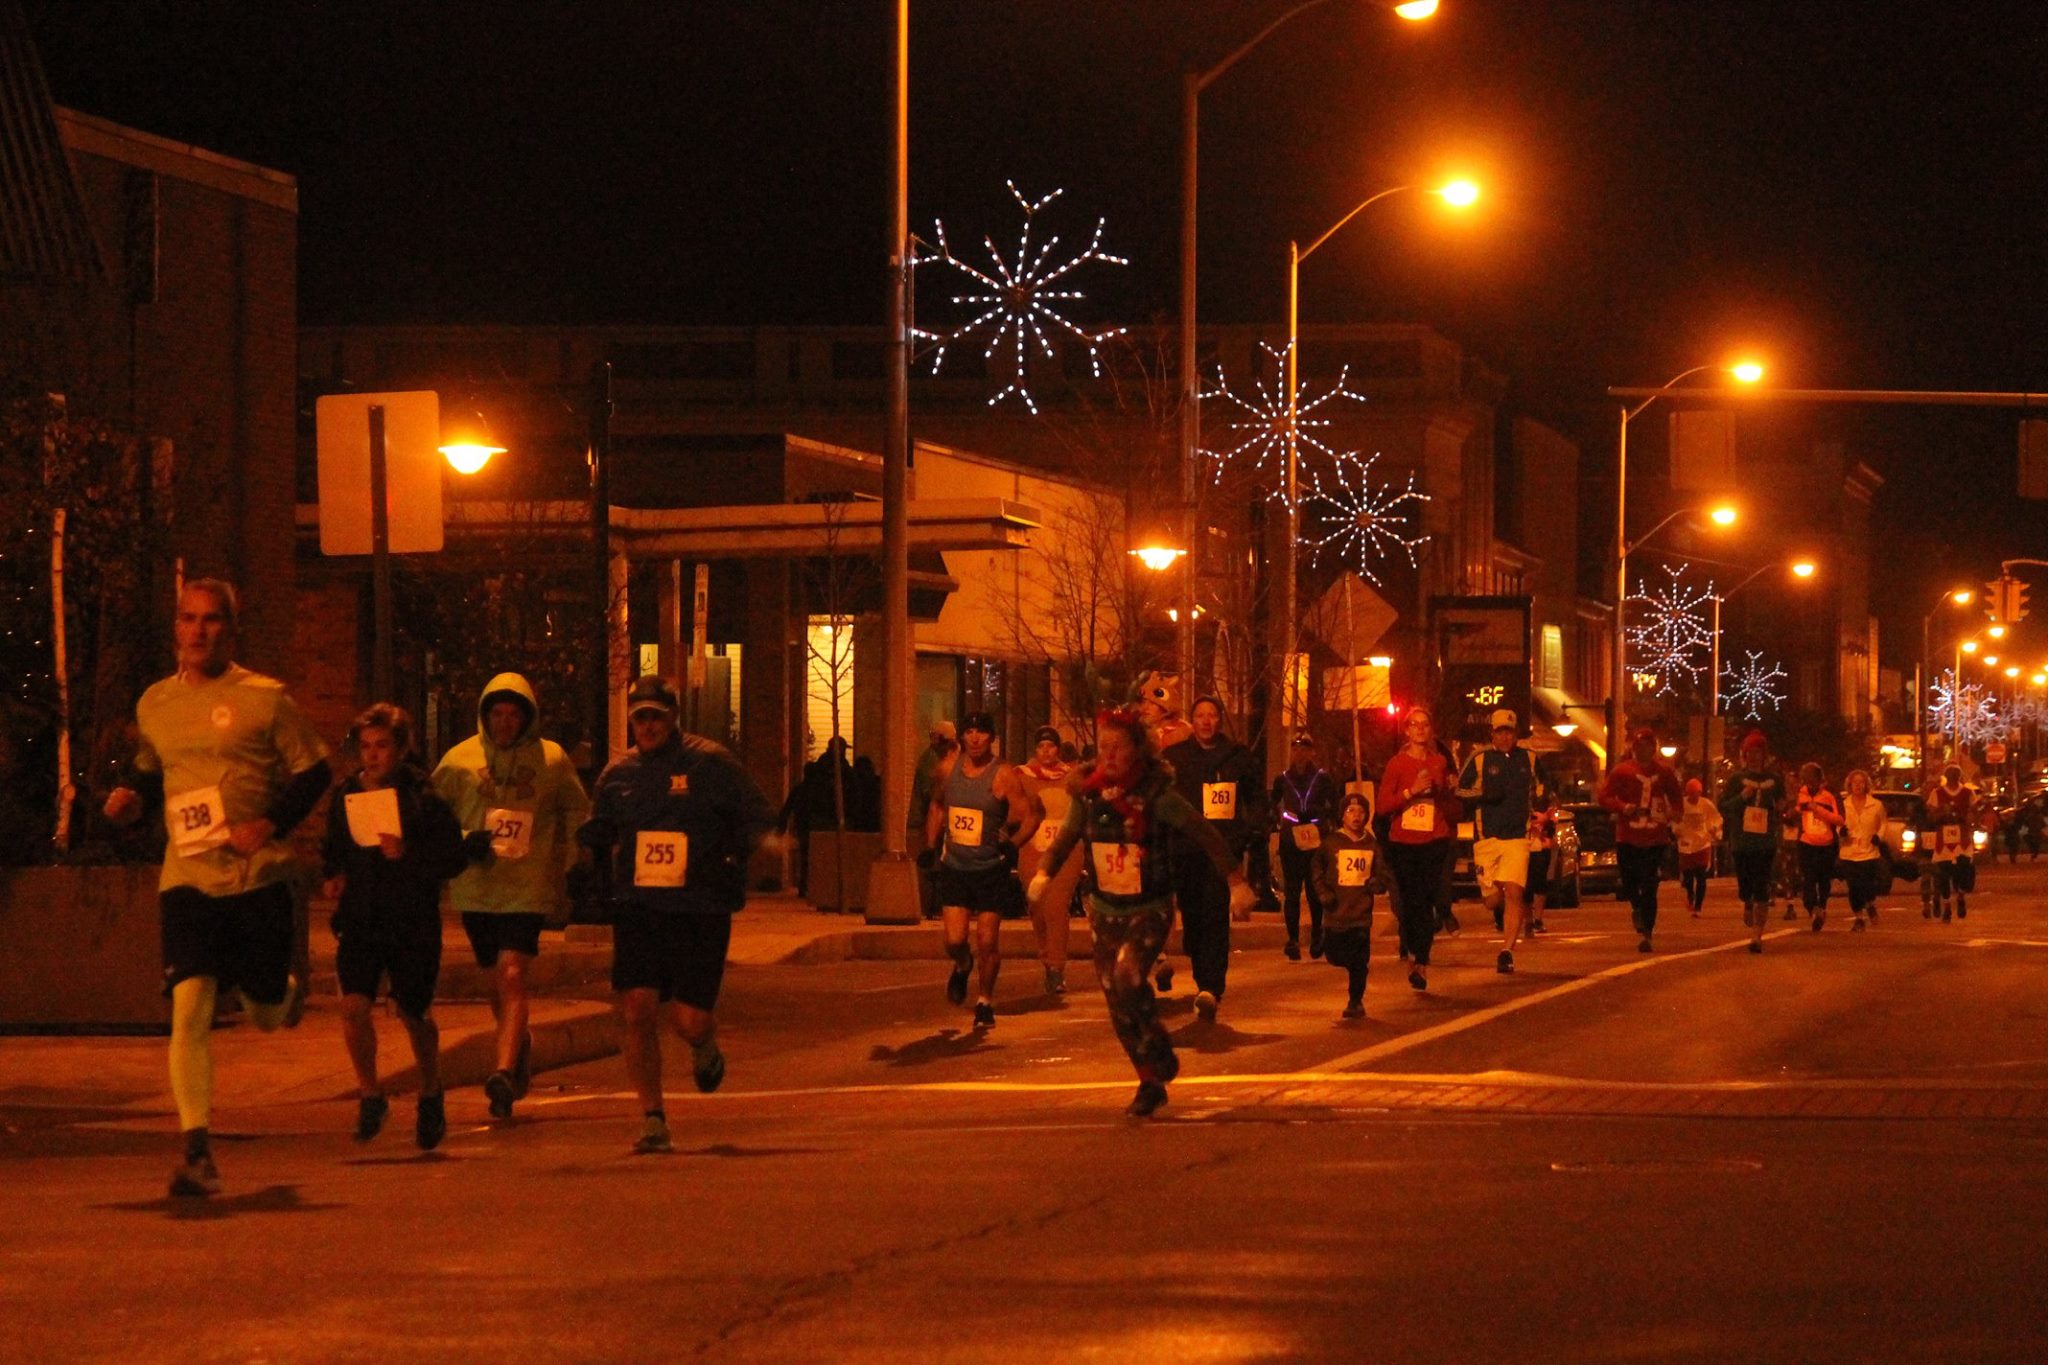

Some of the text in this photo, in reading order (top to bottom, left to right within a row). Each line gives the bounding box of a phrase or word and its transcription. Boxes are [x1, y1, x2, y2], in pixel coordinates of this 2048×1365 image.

[1211, 790, 1230, 804] 263
[181, 803, 212, 830] 238
[954, 816, 974, 831] 252
[494, 820, 523, 839] 257
[645, 843, 675, 864] 255
[1106, 854, 1125, 874] 59
[1346, 857, 1365, 872] 240
